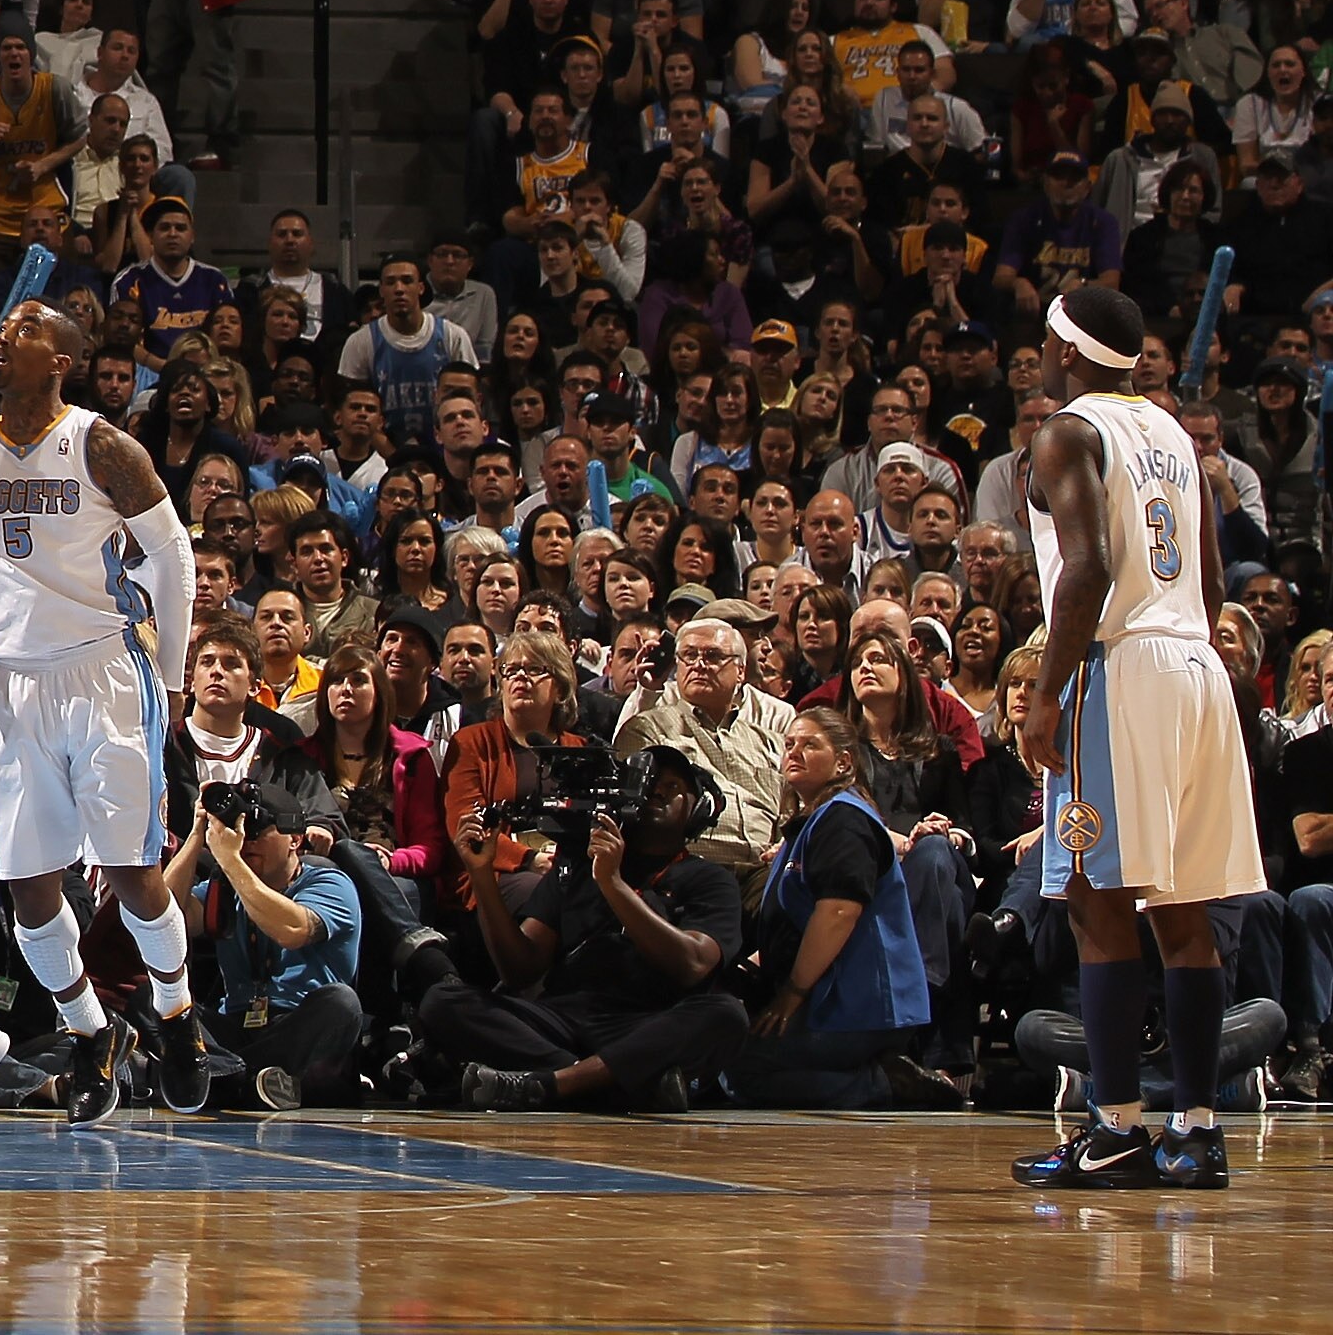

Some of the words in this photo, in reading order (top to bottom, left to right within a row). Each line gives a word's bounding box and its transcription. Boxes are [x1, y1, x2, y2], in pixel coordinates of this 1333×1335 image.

[851, 57, 896, 80] 24
[2, 516, 33, 559] 5
[1145, 497, 1183, 582] 3
